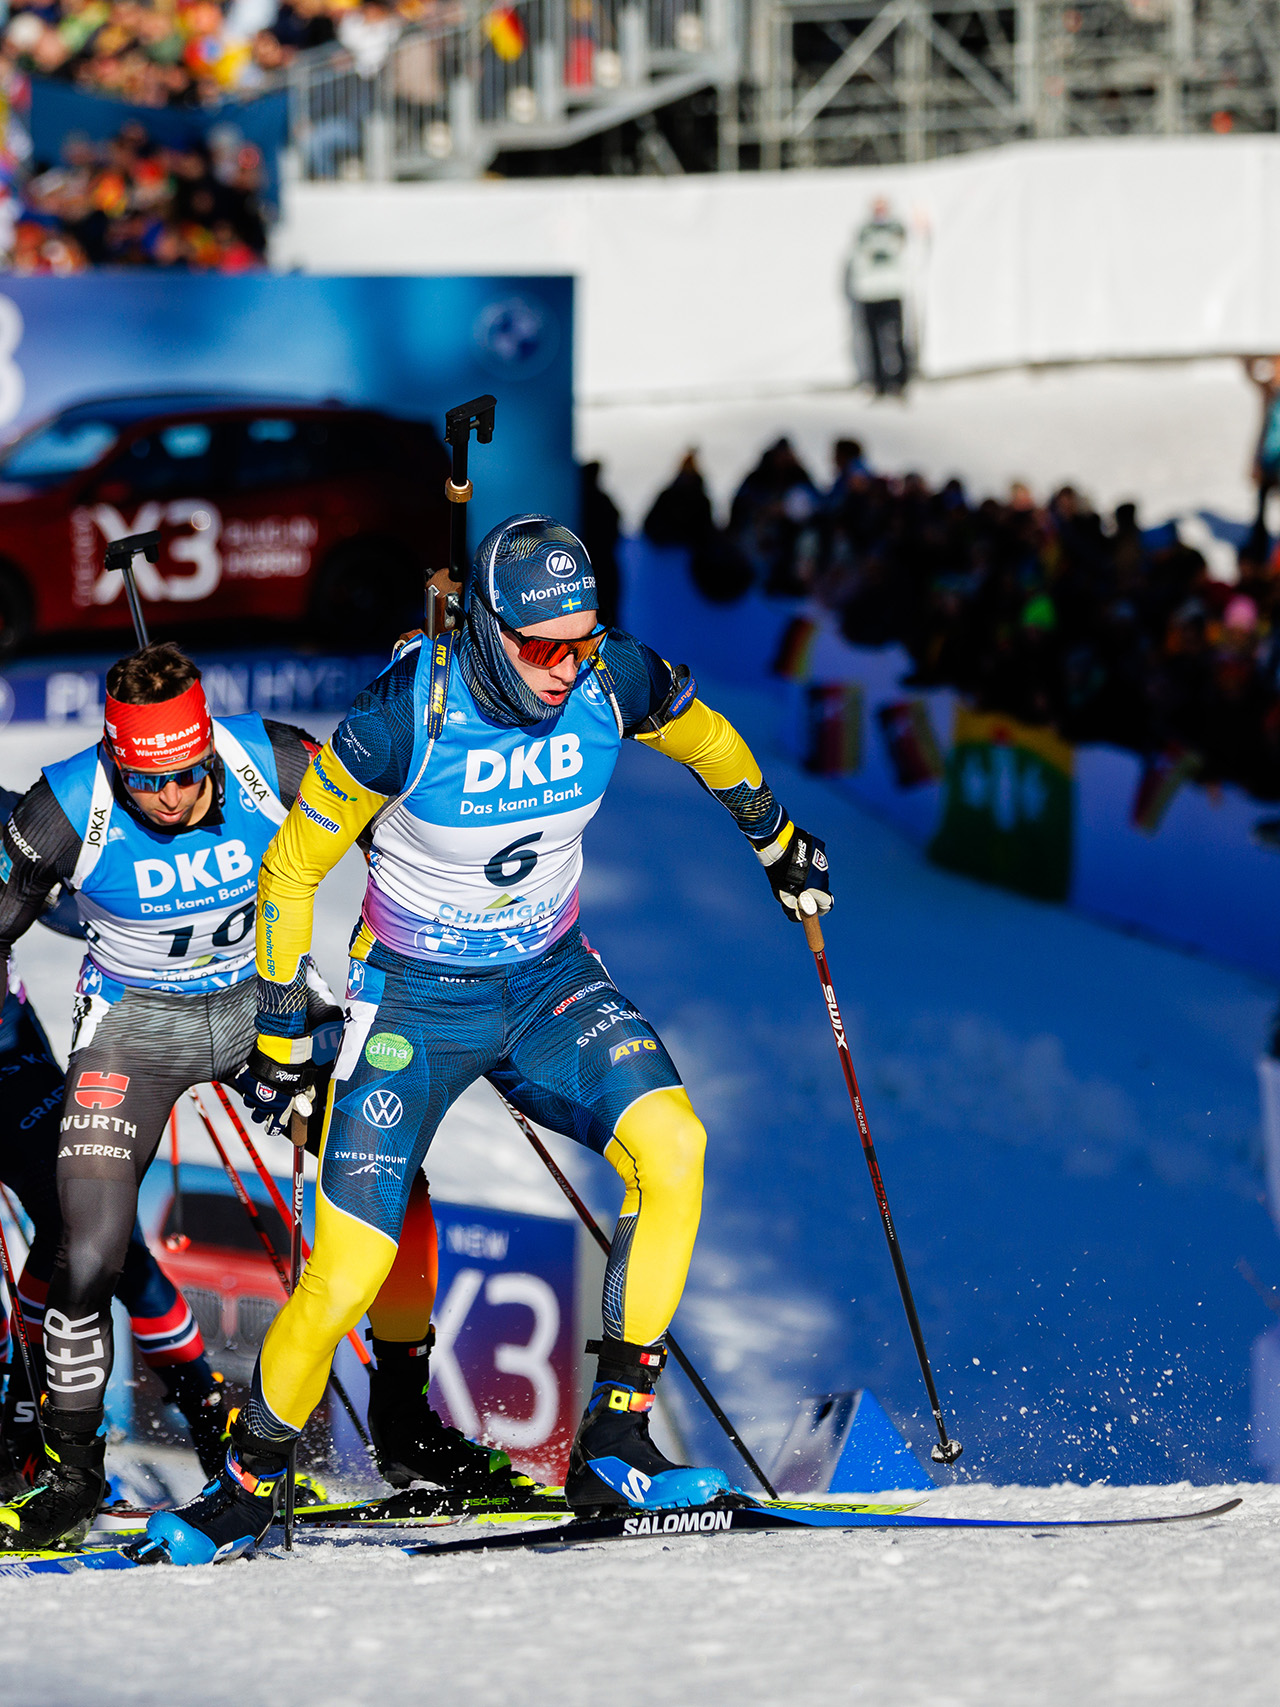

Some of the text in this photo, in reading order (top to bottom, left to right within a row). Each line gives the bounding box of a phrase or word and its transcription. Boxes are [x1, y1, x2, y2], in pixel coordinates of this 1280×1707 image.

[521, 583, 582, 605] Monitor
[435, 643, 448, 667] ATG
[432, 682, 445, 715] ATG
[135, 736, 202, 757] Wärmepumpen
[312, 754, 349, 803] Swegon
[463, 733, 584, 793] DKB
[237, 764, 266, 802] JOKA
[460, 783, 583, 815] Das kann Bank
[7, 817, 42, 863] TERREX
[87, 808, 107, 848] JOKA
[133, 839, 254, 899] DKB
[484, 831, 544, 888] 6
[140, 879, 257, 914] Das kann Bank
[438, 893, 560, 924] CHIEMGAU
[159, 901, 257, 958] 10
[265, 924, 277, 977] Monitor ERP
[370, 1043, 408, 1060] dina
[613, 1039, 658, 1062] ATG
[60, 1114, 137, 1138] WÜRTH
[73, 1144, 132, 1160] TERREX
[334, 1151, 407, 1165] SWEDEMOUNT
[463, 1497, 510, 1507] FISCHER
[622, 1510, 734, 1537] SALOMON
